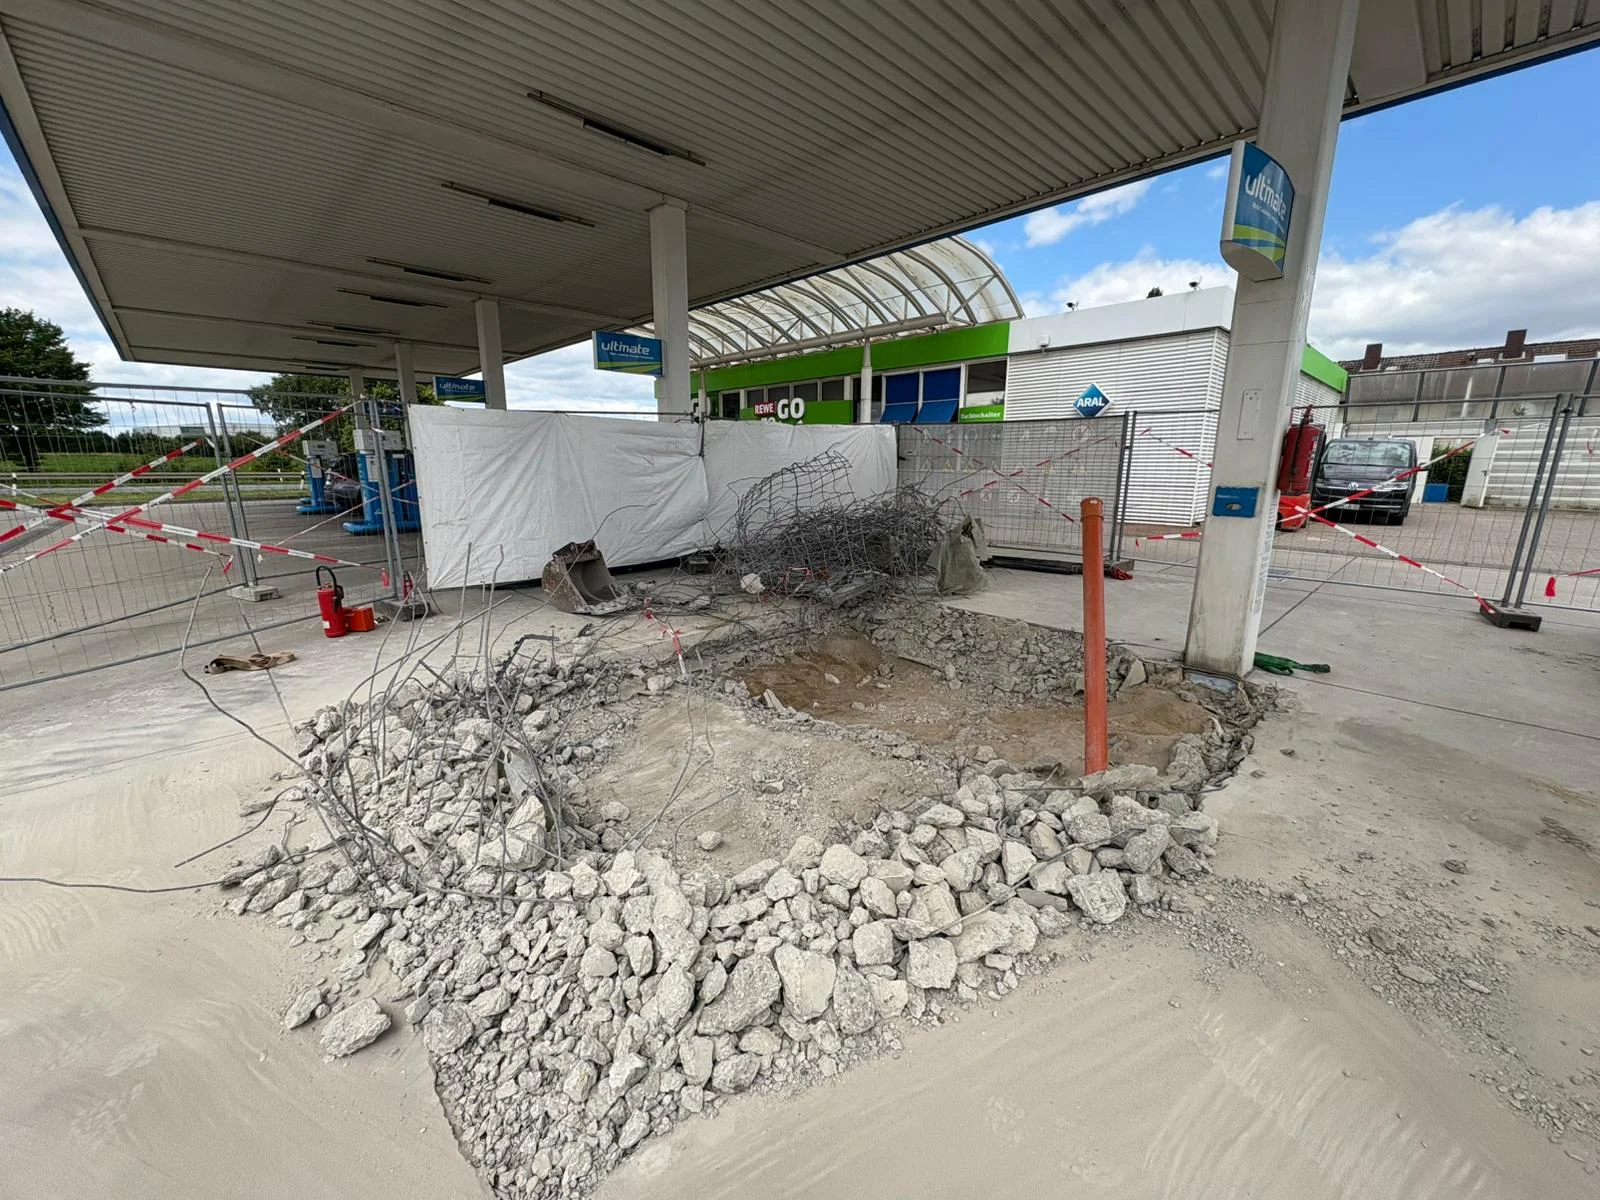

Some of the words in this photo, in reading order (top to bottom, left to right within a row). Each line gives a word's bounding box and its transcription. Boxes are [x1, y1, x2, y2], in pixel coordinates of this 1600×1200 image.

[1245, 171, 1288, 221] ultimate
[601, 340, 650, 355] ultimate
[439, 382, 476, 391] ultimate
[754, 403, 774, 415] REWE
[777, 397, 805, 419] GO
[1076, 397, 1105, 408] ARAL
